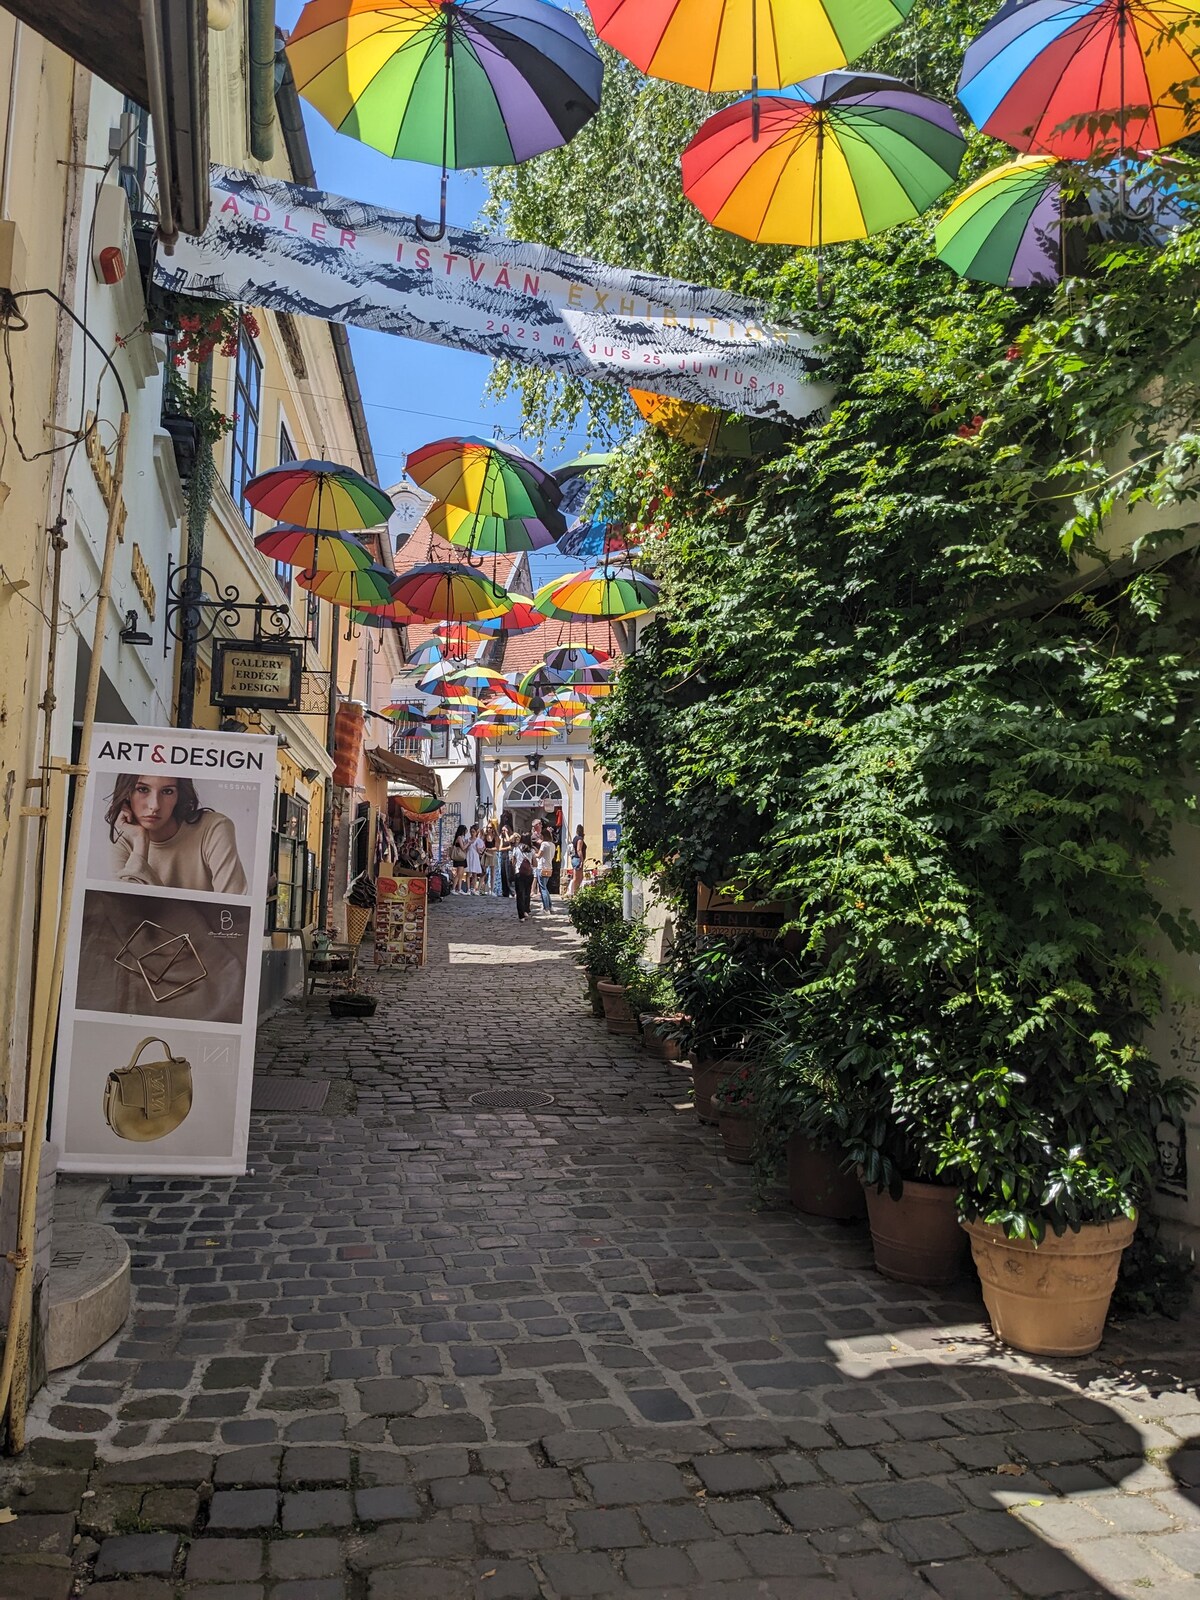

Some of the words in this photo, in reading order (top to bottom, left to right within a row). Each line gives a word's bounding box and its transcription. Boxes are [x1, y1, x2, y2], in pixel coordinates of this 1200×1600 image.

[396, 243, 541, 297] ISTVÁN
[486, 320, 541, 342] 2023
[643, 353, 667, 367] 25,
[231, 657, 284, 670] GALLERY
[235, 669, 279, 681] ERDÉSZ
[239, 682, 281, 693] DESIGN
[98, 740, 264, 771] ART&DESIGN
